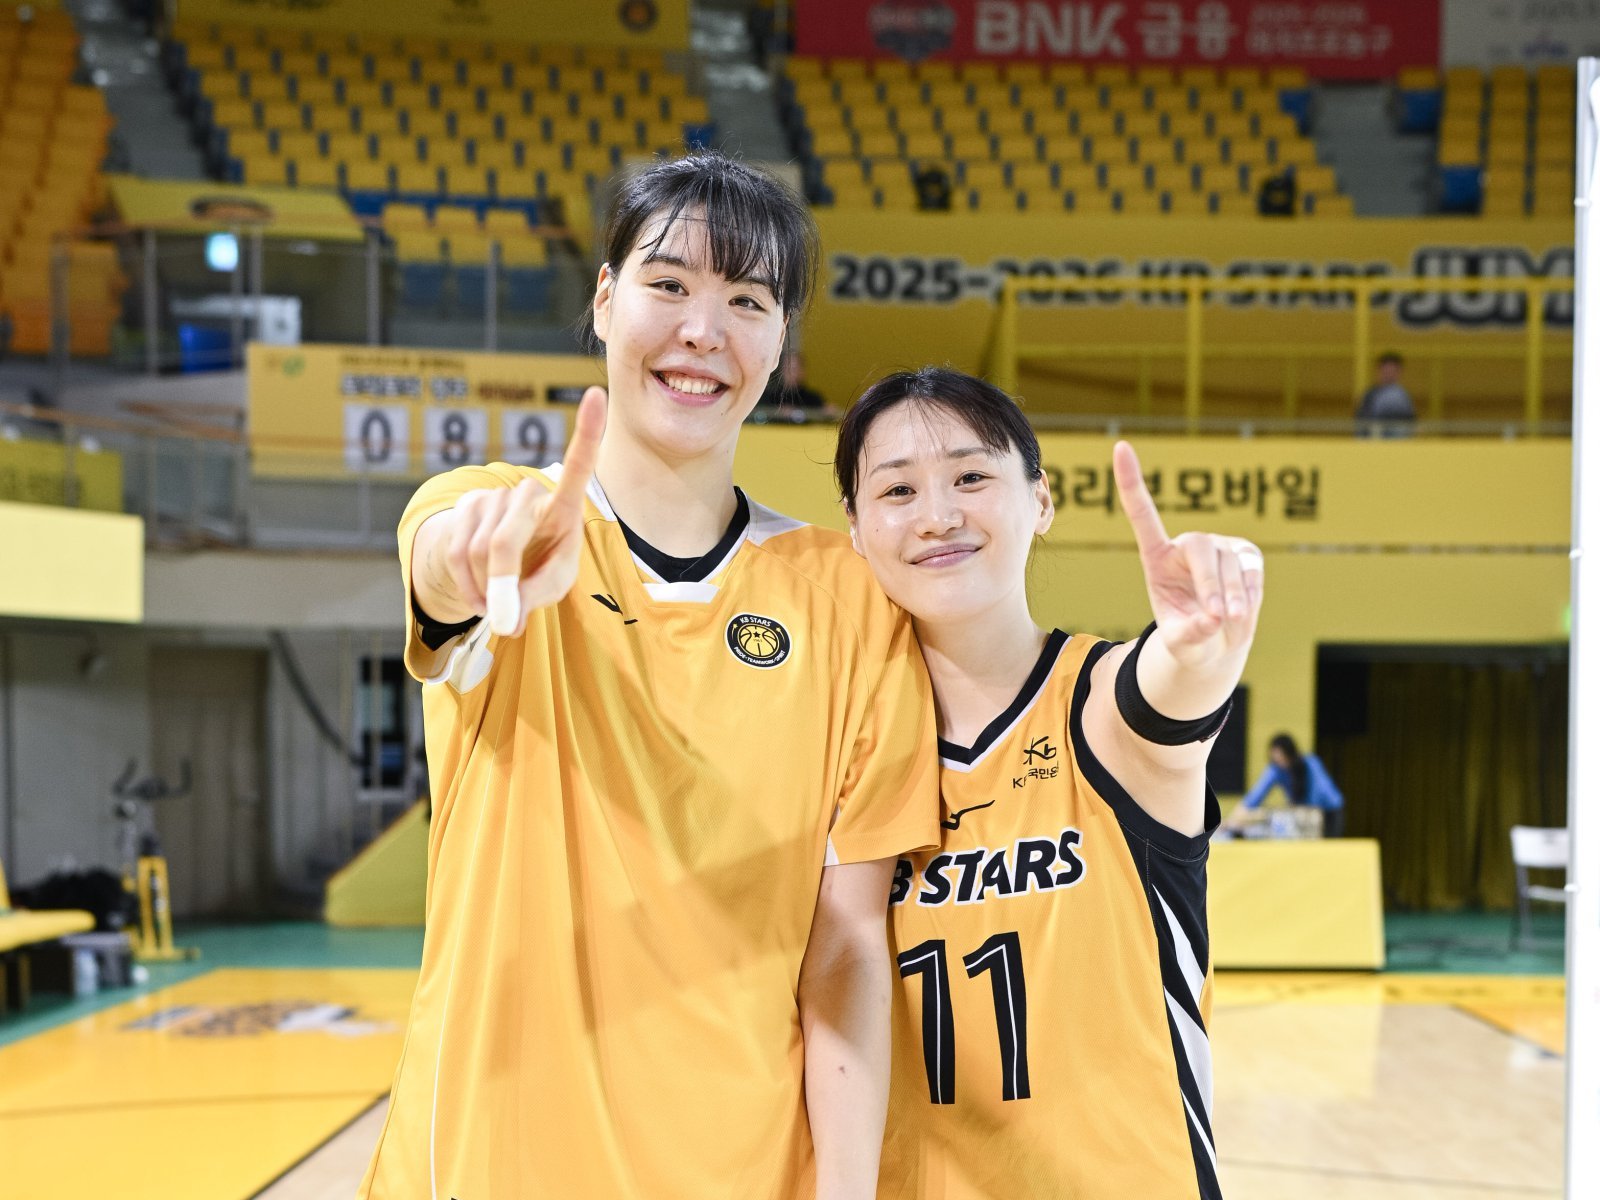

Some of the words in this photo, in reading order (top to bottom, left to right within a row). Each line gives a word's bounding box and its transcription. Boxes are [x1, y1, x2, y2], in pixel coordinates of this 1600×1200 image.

[974, 2, 1128, 56] BNK
[832, 256, 1124, 305] 2025-2026
[1227, 260, 1394, 306] STARS
[361, 410, 392, 463] 0
[440, 413, 469, 465] 8
[518, 415, 548, 466] 9
[739, 616, 749, 624] KB
[749, 616, 772, 627] STARS
[918, 830, 1084, 905] STARS
[896, 931, 1031, 1105] 11
